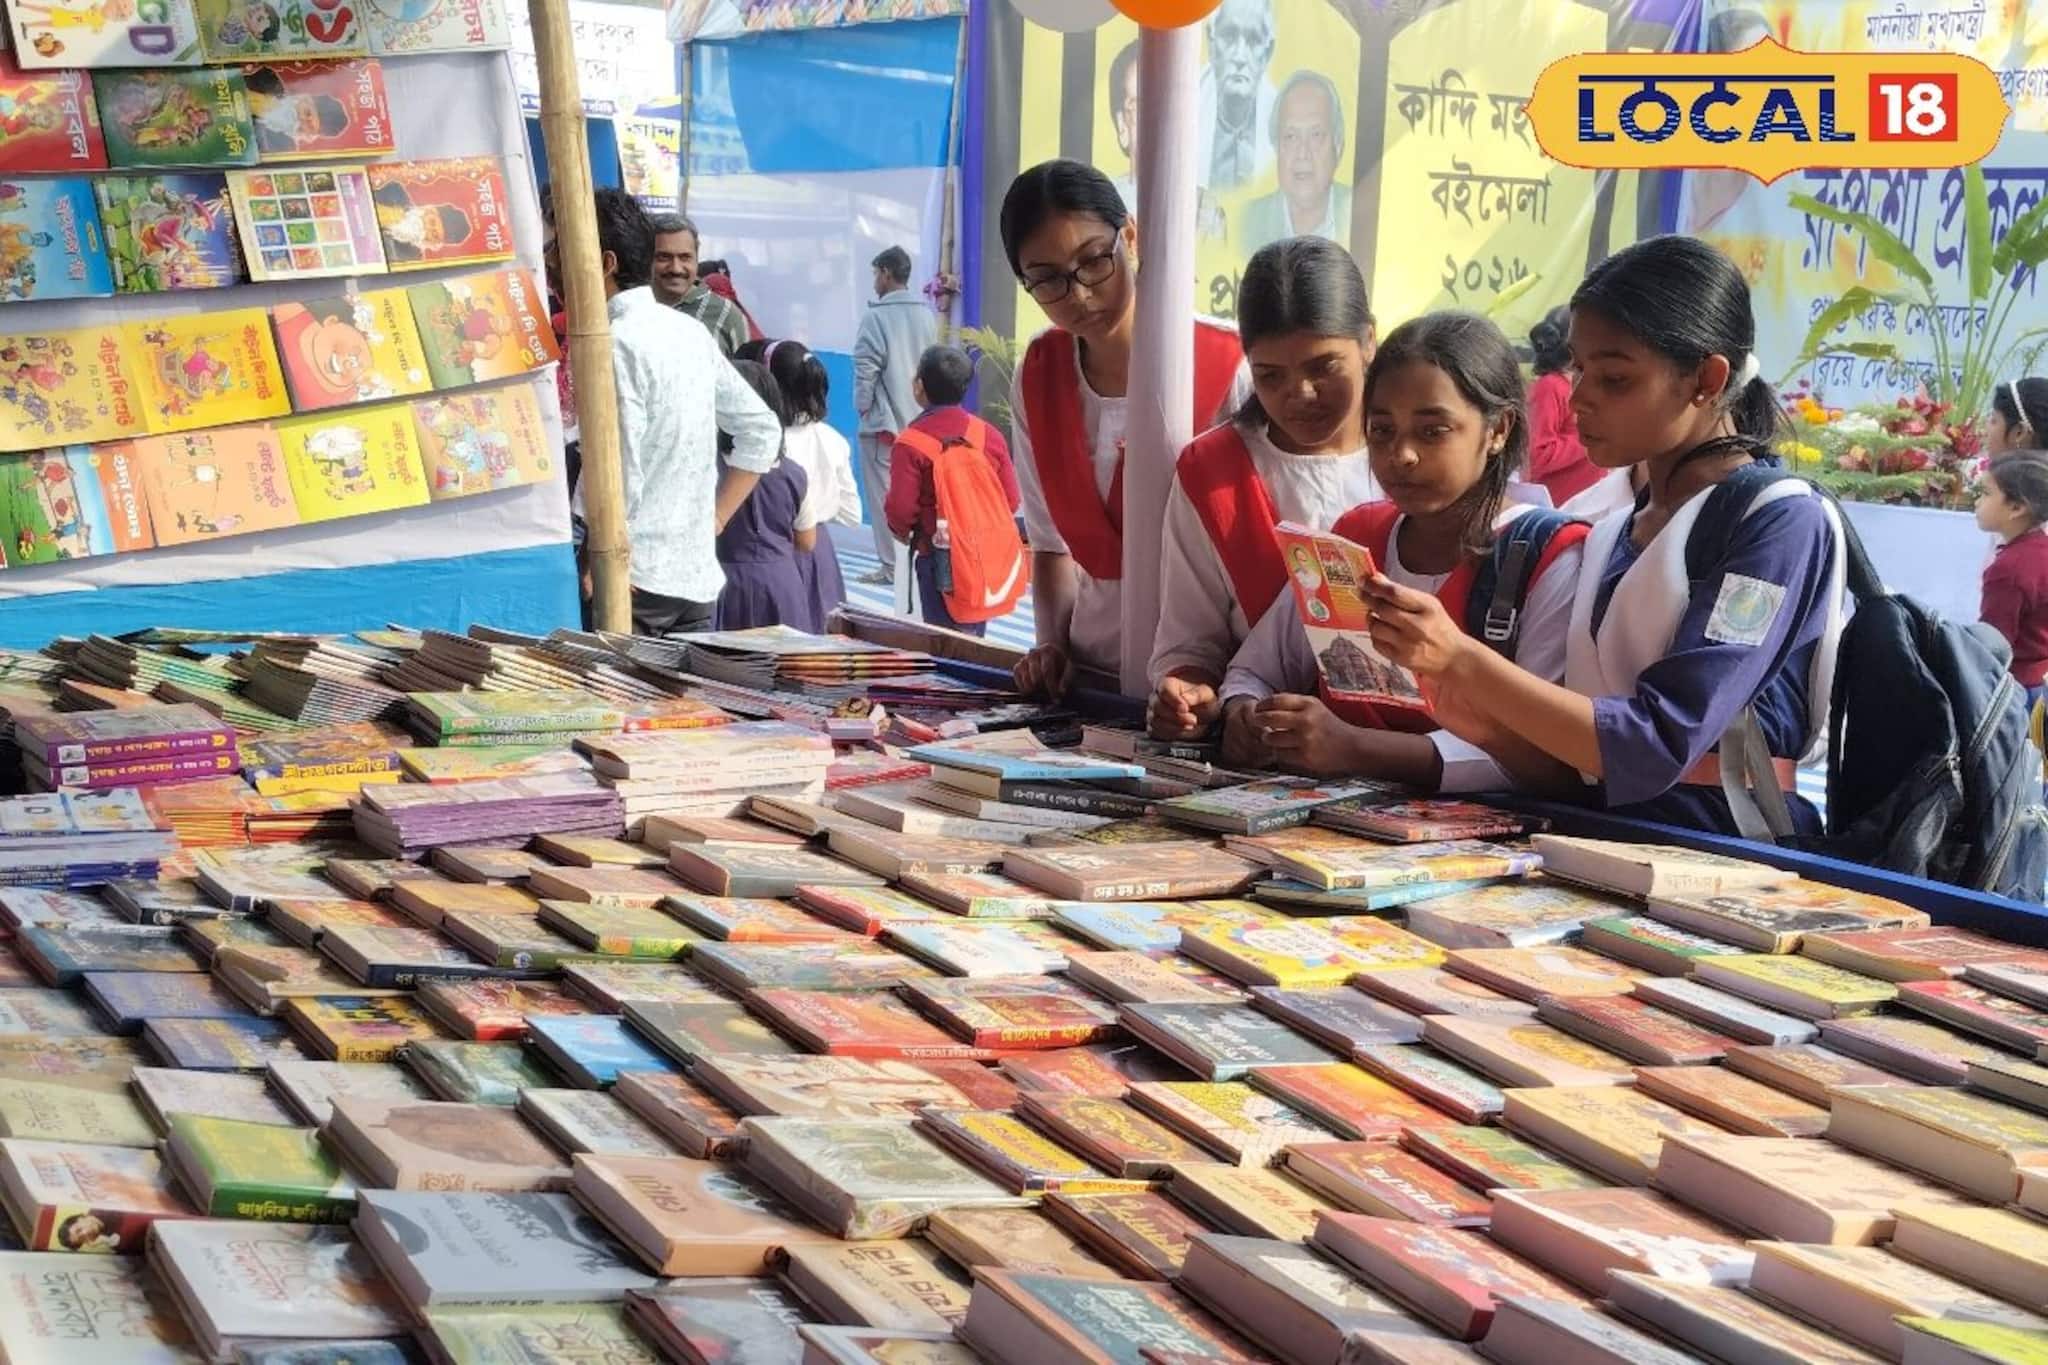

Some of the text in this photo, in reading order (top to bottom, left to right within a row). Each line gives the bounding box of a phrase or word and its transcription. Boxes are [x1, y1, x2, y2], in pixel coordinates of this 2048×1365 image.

[356, 70, 378, 110] সহজ
[1393, 68, 1480, 140] কান্দি
[361, 115, 391, 146] পাঠ
[474, 178, 511, 252] সহজ পাঠ
[1428, 153, 1552, 230] বইমেলা
